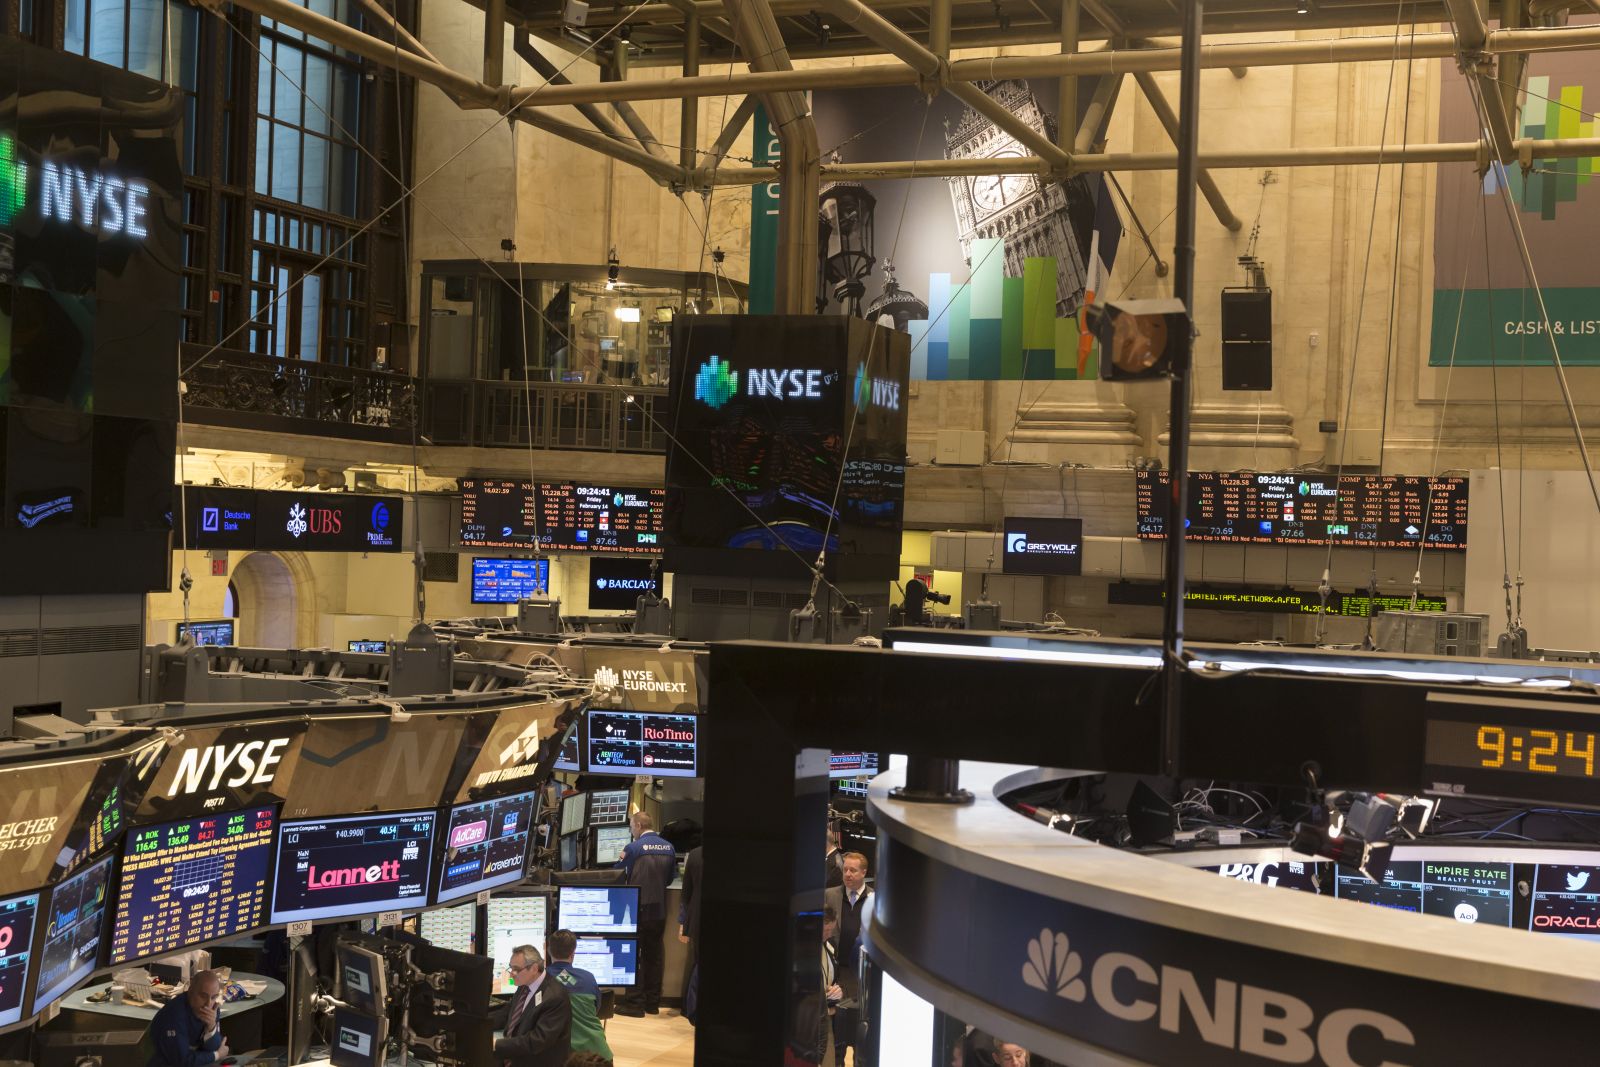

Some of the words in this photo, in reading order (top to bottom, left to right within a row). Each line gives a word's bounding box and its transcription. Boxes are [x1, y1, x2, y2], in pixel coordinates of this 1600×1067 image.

[41, 160, 149, 237] NYSE
[1504, 321, 1548, 334] CASH
[1553, 321, 1565, 334] &
[747, 368, 821, 398] NYSE
[872, 377, 900, 410] NYSE
[463, 481, 474, 489] DJI
[1257, 475, 1295, 485] 09:24:41
[577, 487, 611, 496] 09:24:41
[224, 510, 251, 520] Deutsche
[309, 508, 342, 534] UBS
[223, 521, 239, 530] Bank
[367, 532, 384, 541] PRIME
[595, 537, 618, 545] 97.66
[1280, 529, 1305, 537] 97.66
[1354, 530, 1377, 539] 16.24
[1428, 534, 1453, 542] 46.70
[1027, 543, 1077, 551] GREYWOLF
[1184, 592, 1301, 604] IDATED.TAPE.NETWORK.A.FEB
[622, 669, 654, 681] NYSE
[643, 727, 694, 743] RioTinto
[1477, 726, 1595, 776] 9:24
[167, 738, 290, 796] NYSE
[611, 757, 636, 766] Nitrogen
[0, 816, 59, 840] EICHER
[145, 830, 159, 839] ROK
[177, 824, 190, 834] ROP
[233, 814, 246, 824] RSG
[288, 833, 299, 844] LCI
[379, 827, 397, 835] 40.54
[412, 823, 430, 832] 41.19
[135, 841, 157, 852] 116.45
[167, 834, 190, 846] 136.49
[197, 830, 215, 840] 84.21
[226, 825, 244, 836] 34.06
[255, 820, 272, 831] 95.29
[454, 826, 483, 843] AdCare
[122, 863, 138, 872] PRESS
[138, 860, 160, 869] RELEASE:
[160, 857, 172, 865] WWE
[195, 849, 210, 858] Extend
[210, 848, 218, 856] Toy
[218, 844, 238, 853] Licensing
[238, 841, 259, 851] Agreement
[140, 851, 156, 861] Europe
[156, 849, 168, 857] Offer
[174, 846, 188, 854] Match
[188, 841, 212, 851] MasterCard
[220, 838, 229, 846] Cap
[402, 853, 418, 861] NYSE
[489, 854, 523, 872] crexendo
[309, 859, 401, 888] Lannett
[1218, 862, 1279, 889] P&G
[1289, 867, 1305, 875] NYSE
[1427, 865, 1469, 877] EMPIRE
[1473, 869, 1507, 880] STATE
[1437, 876, 1467, 884] REALTY
[183, 884, 210, 898] 09:24:20
[384, 913, 398, 921] 3131
[292, 922, 307, 931] 1307
[1090, 951, 1416, 1067] CNBC
